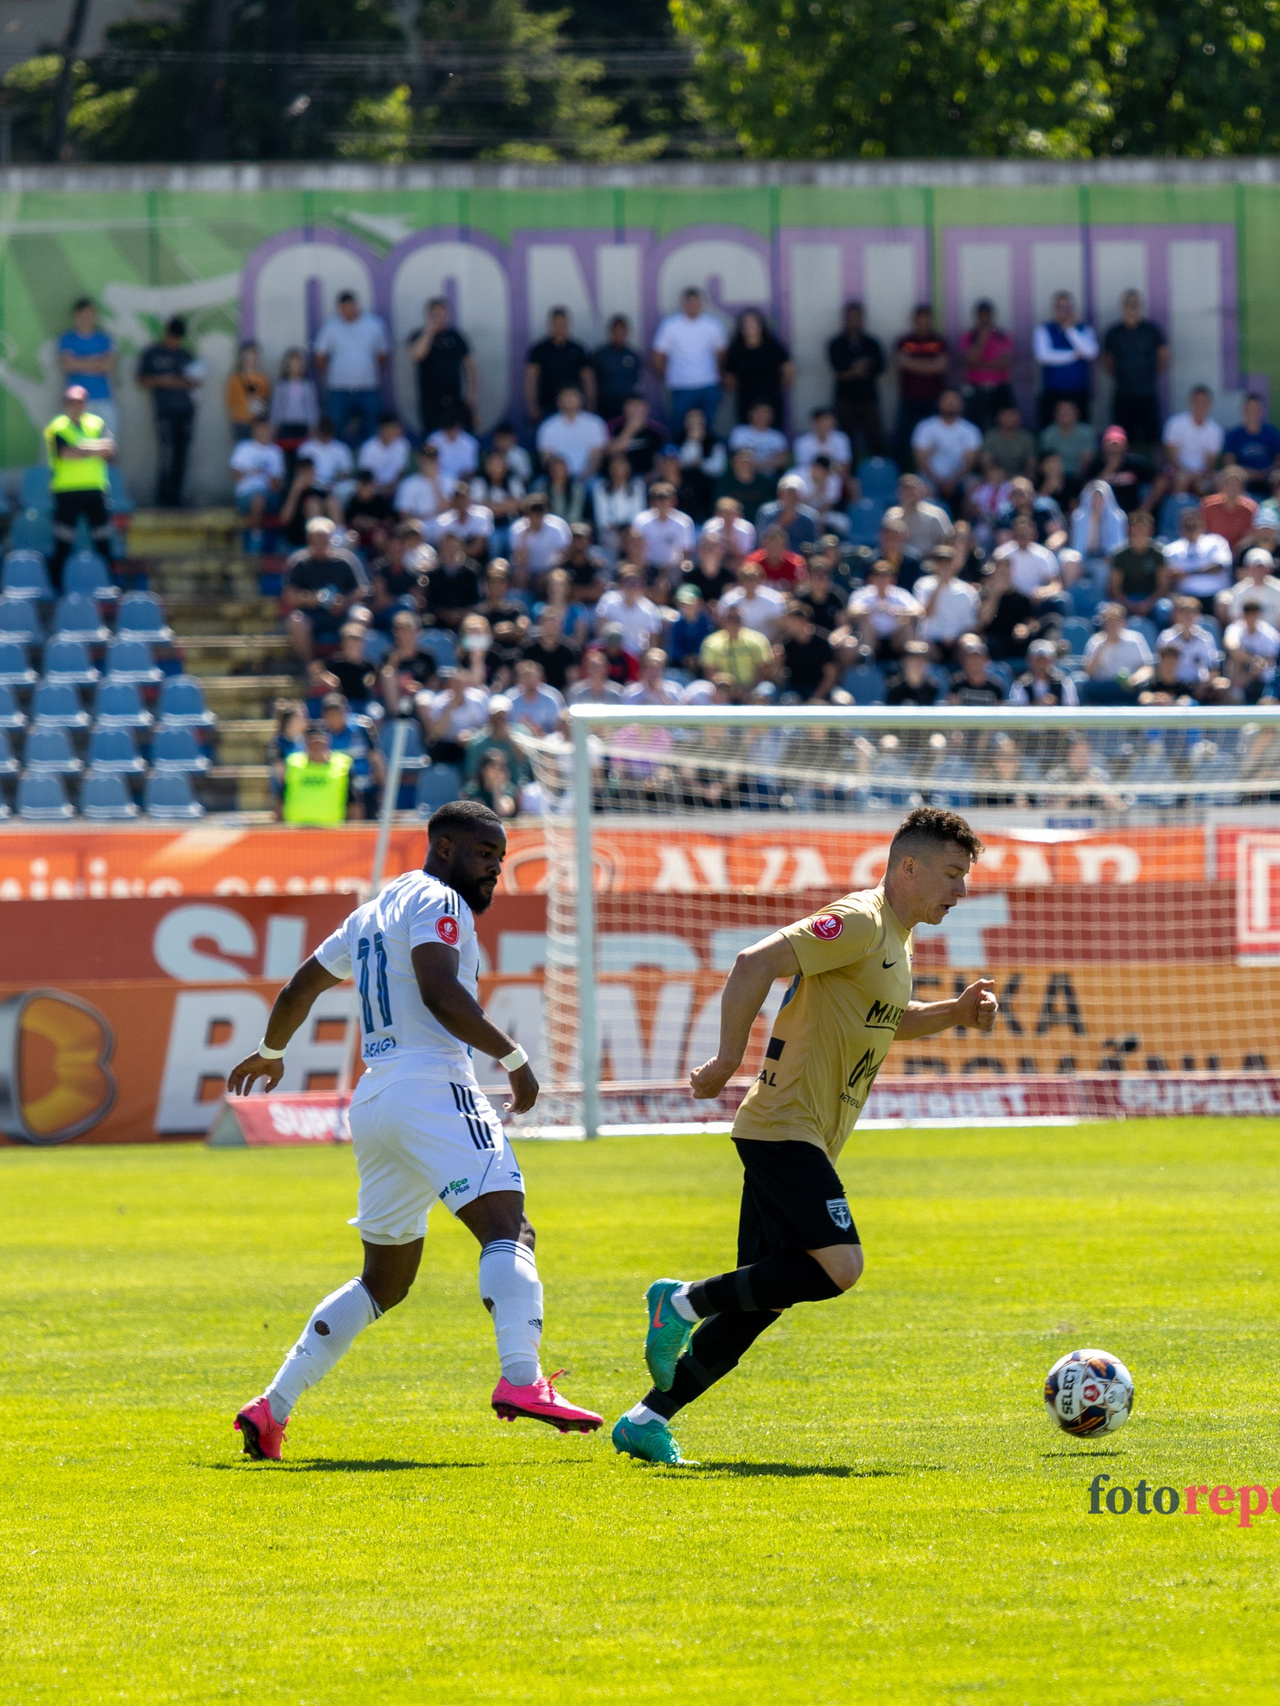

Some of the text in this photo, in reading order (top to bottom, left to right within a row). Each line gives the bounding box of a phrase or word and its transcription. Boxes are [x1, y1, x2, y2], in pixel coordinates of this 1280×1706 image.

[357, 931, 393, 1035] 11
[450, 1178, 468, 1191] Eco
[1062, 1368, 1077, 1415] SELECT
